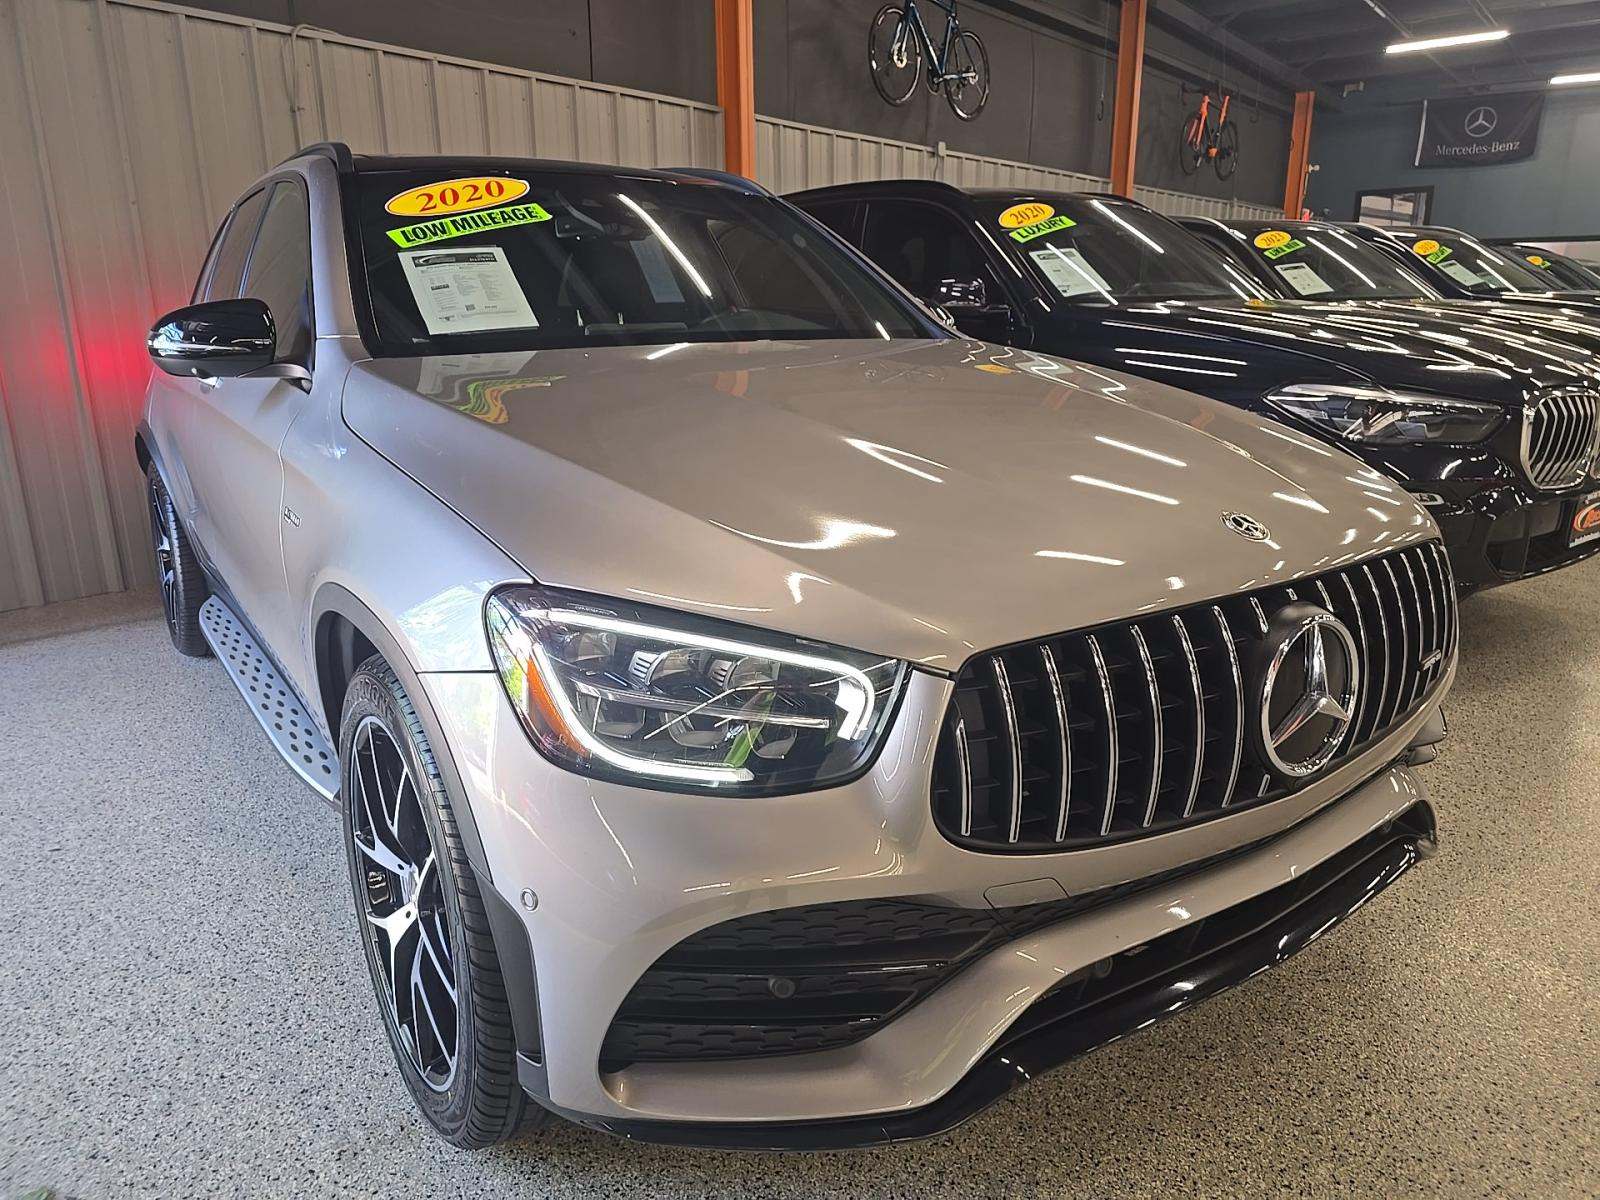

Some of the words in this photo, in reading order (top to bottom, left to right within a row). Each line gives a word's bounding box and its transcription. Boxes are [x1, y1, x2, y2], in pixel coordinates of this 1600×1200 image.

[1435, 140, 1521, 156] Mercedes-Benz
[415, 180, 504, 212] 2020
[400, 222, 447, 243] LOW
[451, 205, 538, 232] MILEAGE
[1010, 205, 1045, 224] 2020
[1016, 217, 1065, 238] LUXURY
